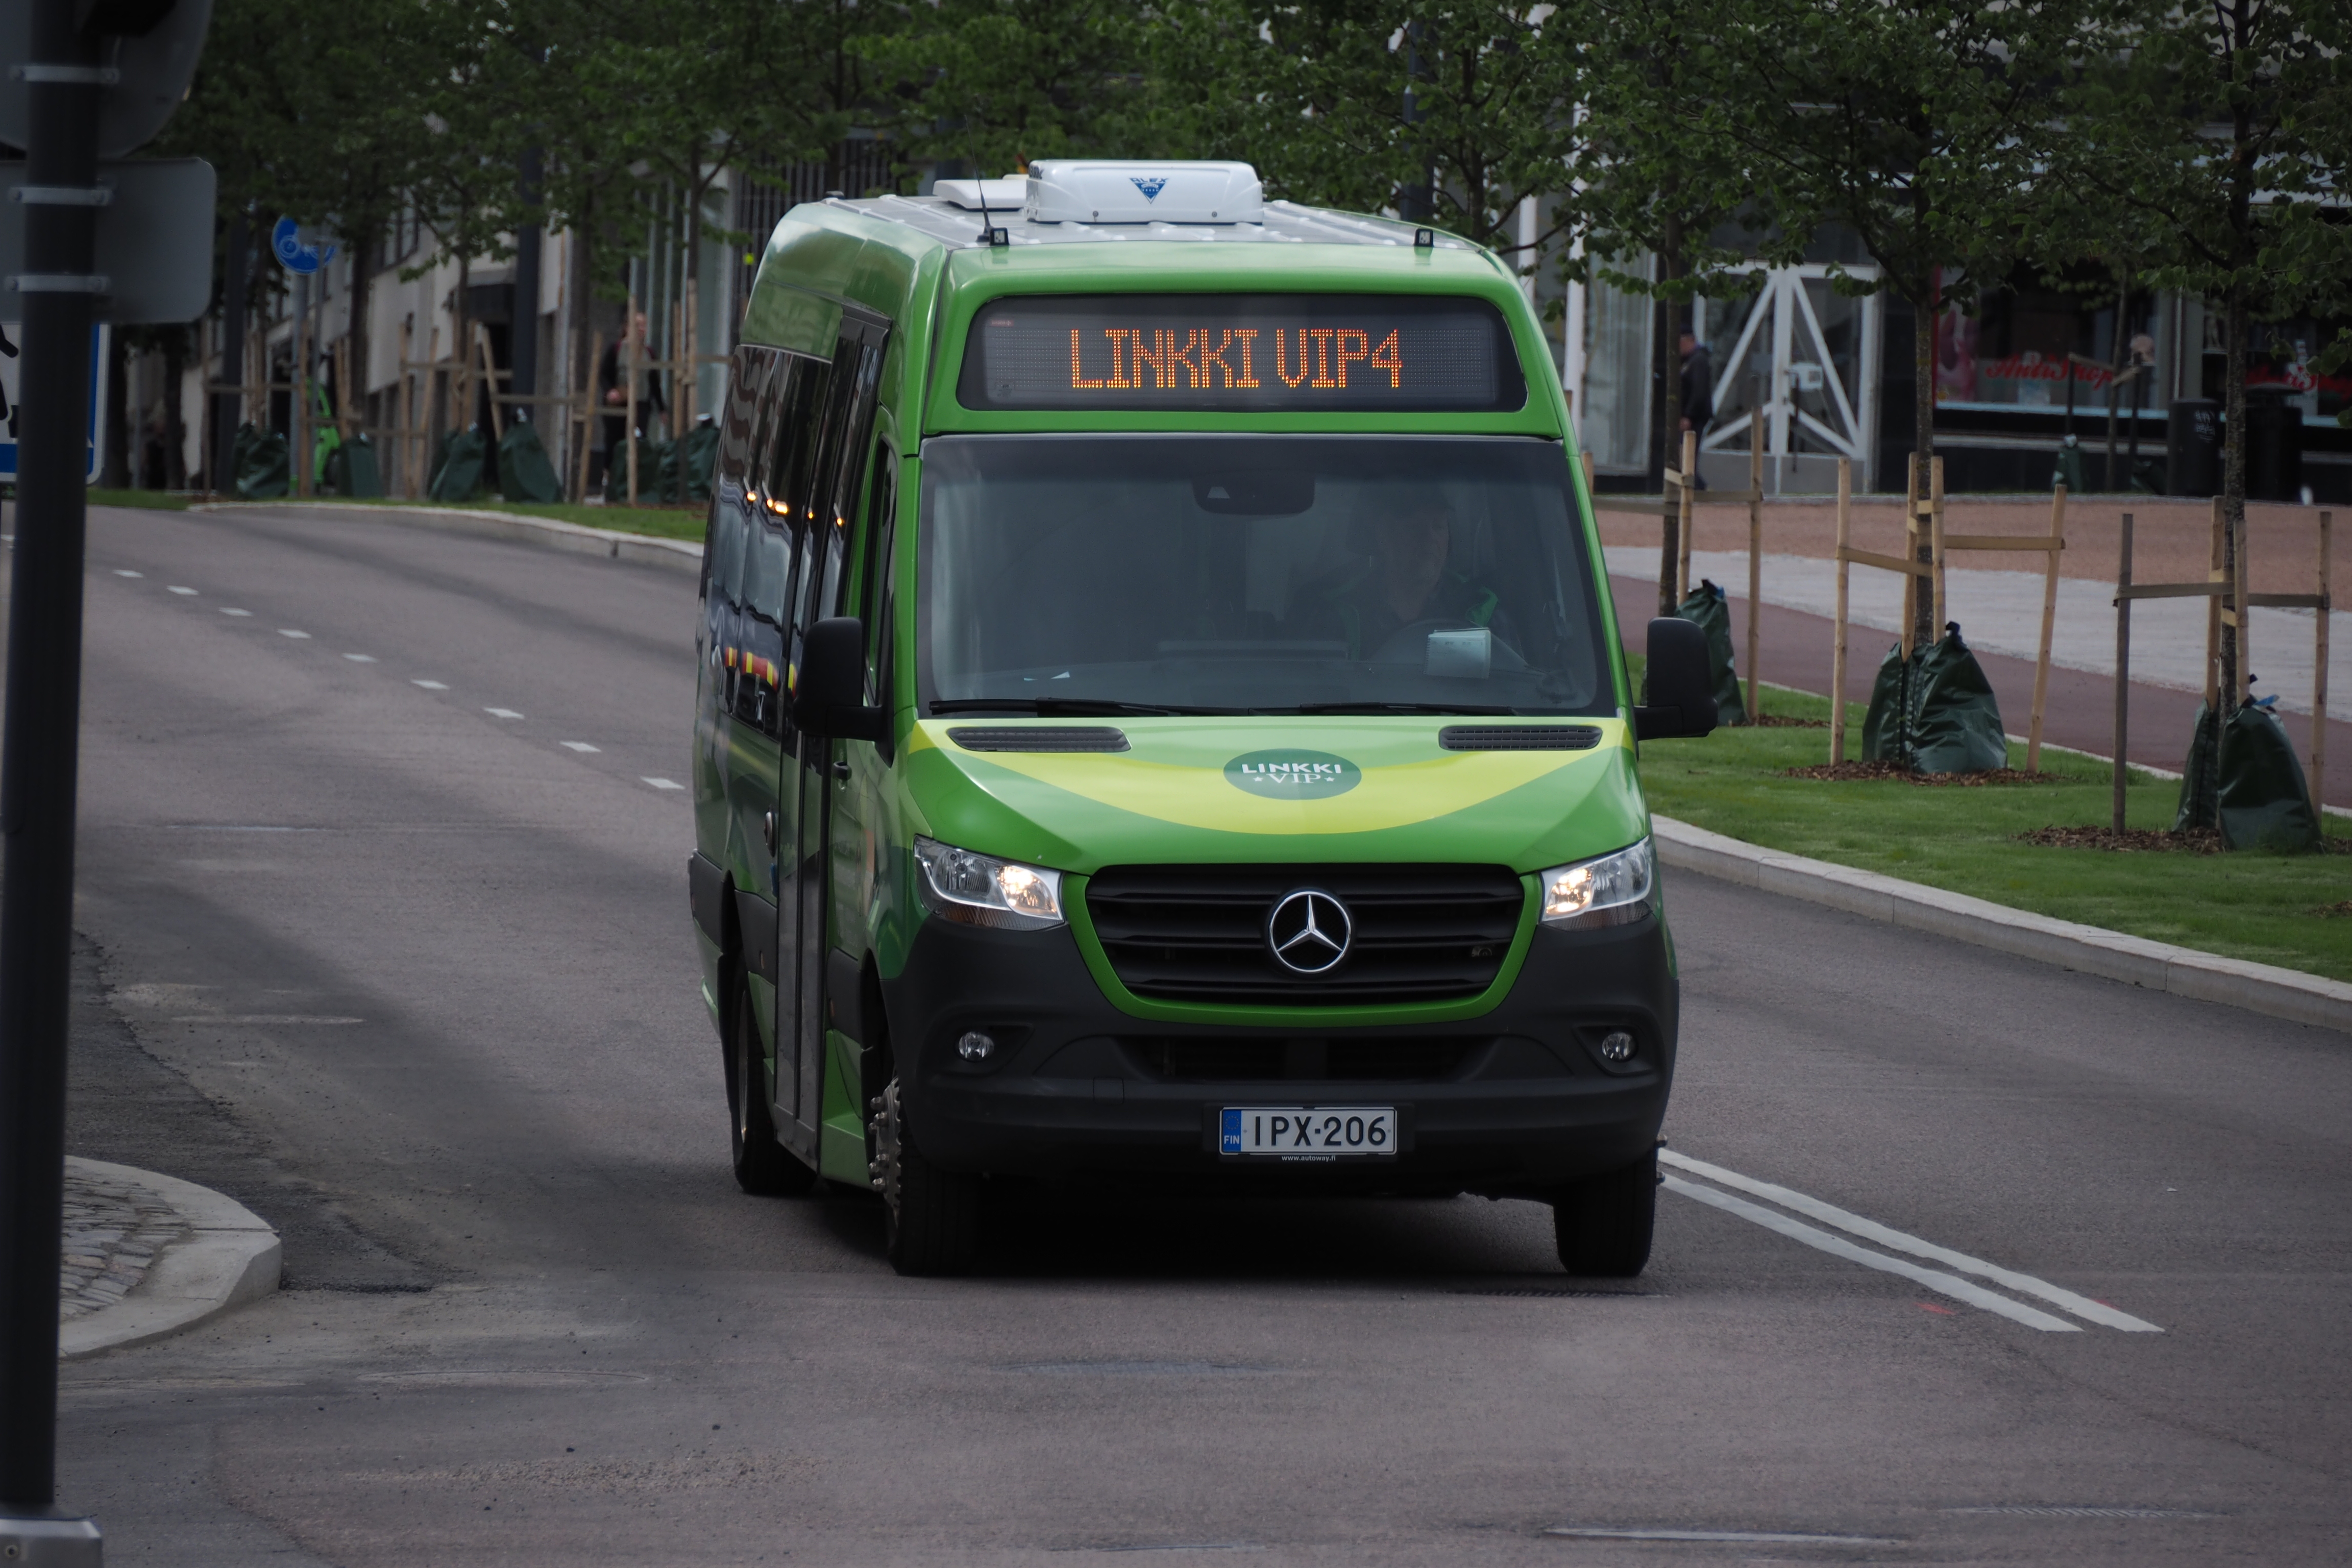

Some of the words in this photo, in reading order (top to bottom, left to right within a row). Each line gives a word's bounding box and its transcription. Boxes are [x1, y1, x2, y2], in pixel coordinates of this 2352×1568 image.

[1071, 329, 1260, 388] LINKKI
[1277, 329, 1403, 388] VIP4
[1242, 763, 1341, 774] LINKKI
[1266, 773, 1321, 783] VIP
[1255, 1116, 1386, 1146] IPX-206
[1224, 1135, 1240, 1144] FIN
